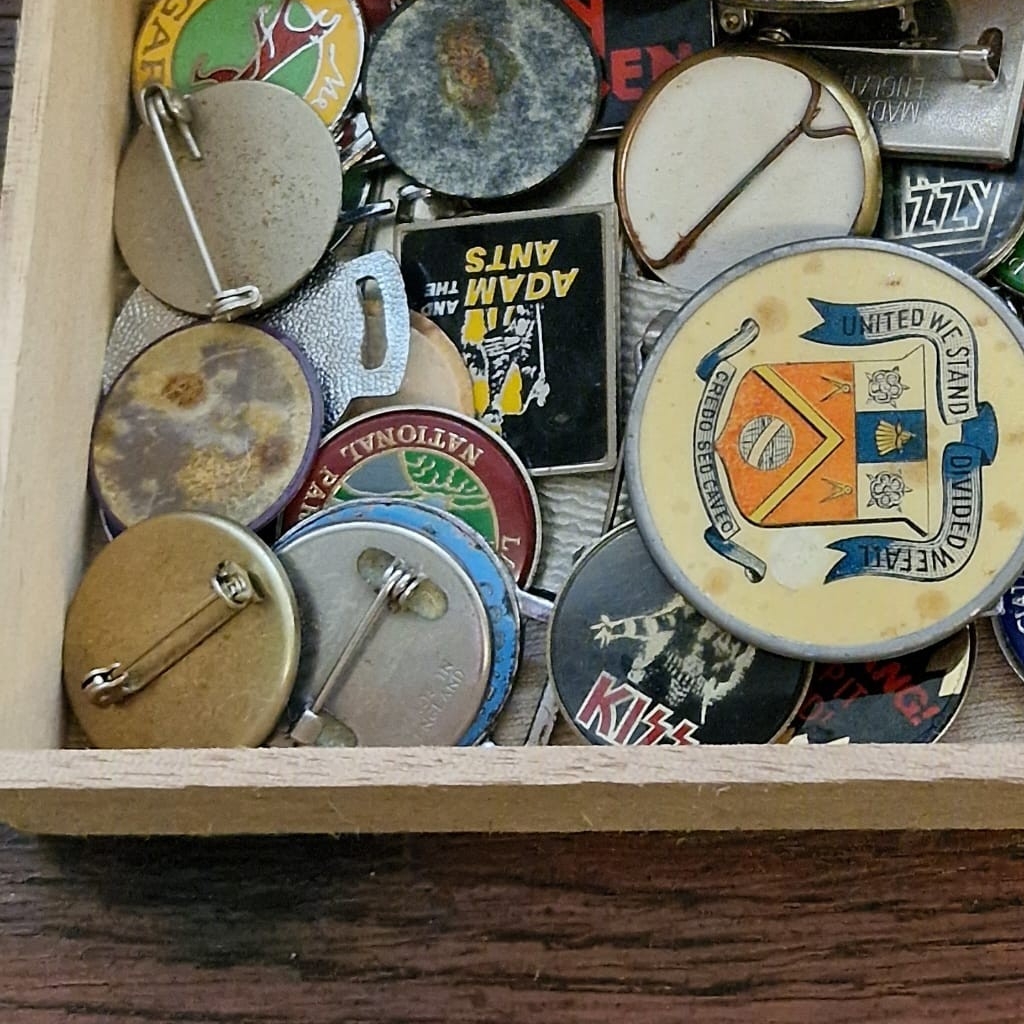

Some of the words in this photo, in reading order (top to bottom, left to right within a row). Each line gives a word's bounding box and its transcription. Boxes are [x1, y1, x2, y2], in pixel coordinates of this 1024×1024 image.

[464, 239, 560, 273] ANTS
[423, 280, 460, 298] THE
[463, 267, 580, 307] ADAM
[420, 299, 460, 317] AND
[842, 307, 925, 337] UNITED
[929, 308, 956, 342] WE
[945, 346, 971, 416] STAND
[699, 370, 729, 433] CREDO
[338, 422, 485, 467] NATIONAL
[696, 440, 713, 474] SED
[703, 479, 734, 533] CAVEO
[945, 454, 973, 551] DIVIDED
[916, 546, 955, 573] WE
